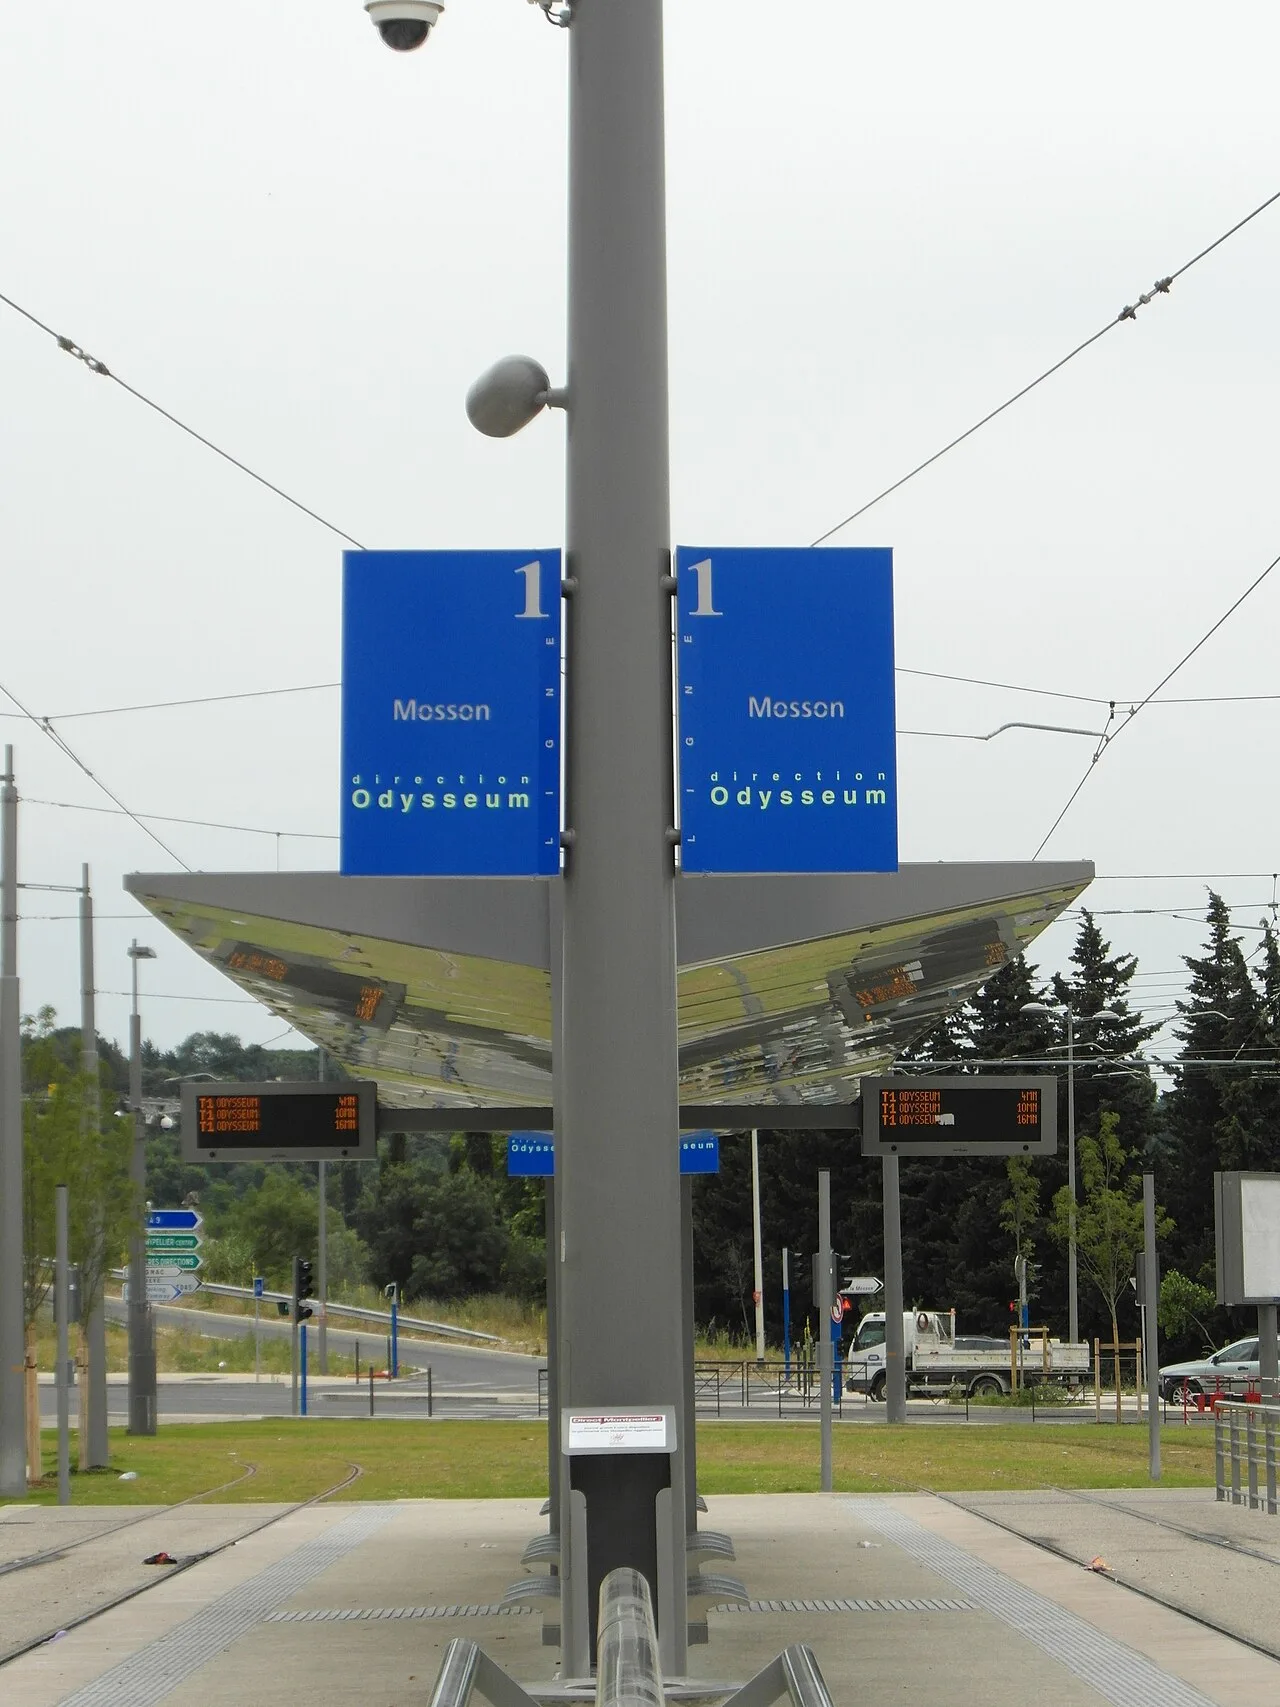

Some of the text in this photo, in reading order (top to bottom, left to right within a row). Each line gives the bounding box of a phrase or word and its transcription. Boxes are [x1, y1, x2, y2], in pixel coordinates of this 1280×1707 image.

[514, 560, 550, 618] 1
[688, 558, 723, 616] 1
[393, 699, 490, 721] Mosson
[749, 697, 844, 718] Mosson
[352, 774, 529, 785] direction
[710, 771, 886, 782] direction
[352, 789, 529, 813] Odysseum
[710, 786, 886, 810] Odysseum
[882, 1091, 1038, 1102] T1 ODYSSEUM 4MN
[200, 1098, 214, 1109] T1
[217, 1097, 258, 1108] ODYSSEUM
[882, 1103, 1038, 1114] T1 ODYSSEUM 10MN
[200, 1110, 214, 1121] T1
[217, 1109, 258, 1120] ODYSSEUM
[882, 1115, 896, 1126] T1
[1017, 1114, 1038, 1124] 16MN
[200, 1121, 214, 1132] T1
[217, 1120, 258, 1131] ODYSSEUM
[511, 1144, 554, 1154] Odysse
